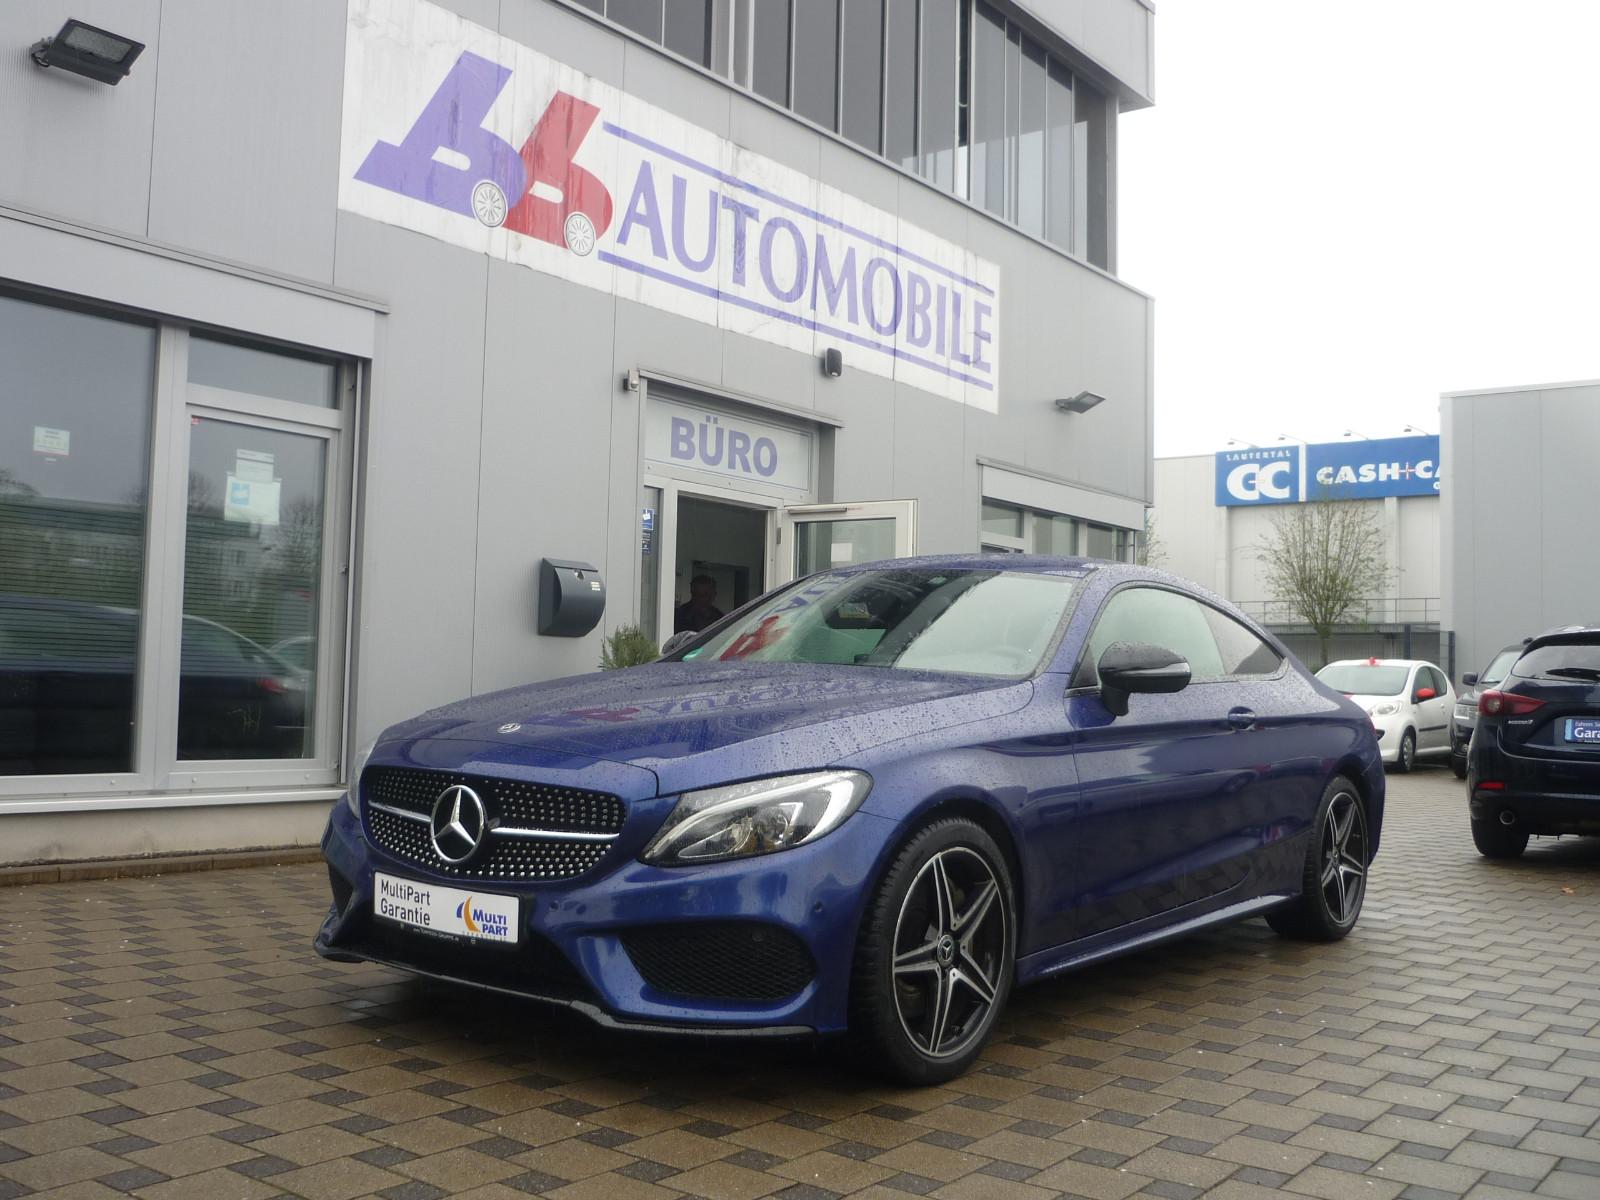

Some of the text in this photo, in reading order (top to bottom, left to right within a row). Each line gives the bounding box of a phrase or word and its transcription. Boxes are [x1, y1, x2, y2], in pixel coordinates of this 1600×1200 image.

[616, 160, 992, 372] AUTOMOBILE
[670, 415, 778, 477] BÜRO
[1226, 450, 1291, 461] LAUTERTAL
[381, 879, 431, 906] MultiPart
[380, 898, 431, 926] Garantie
[482, 923, 509, 937] PART
